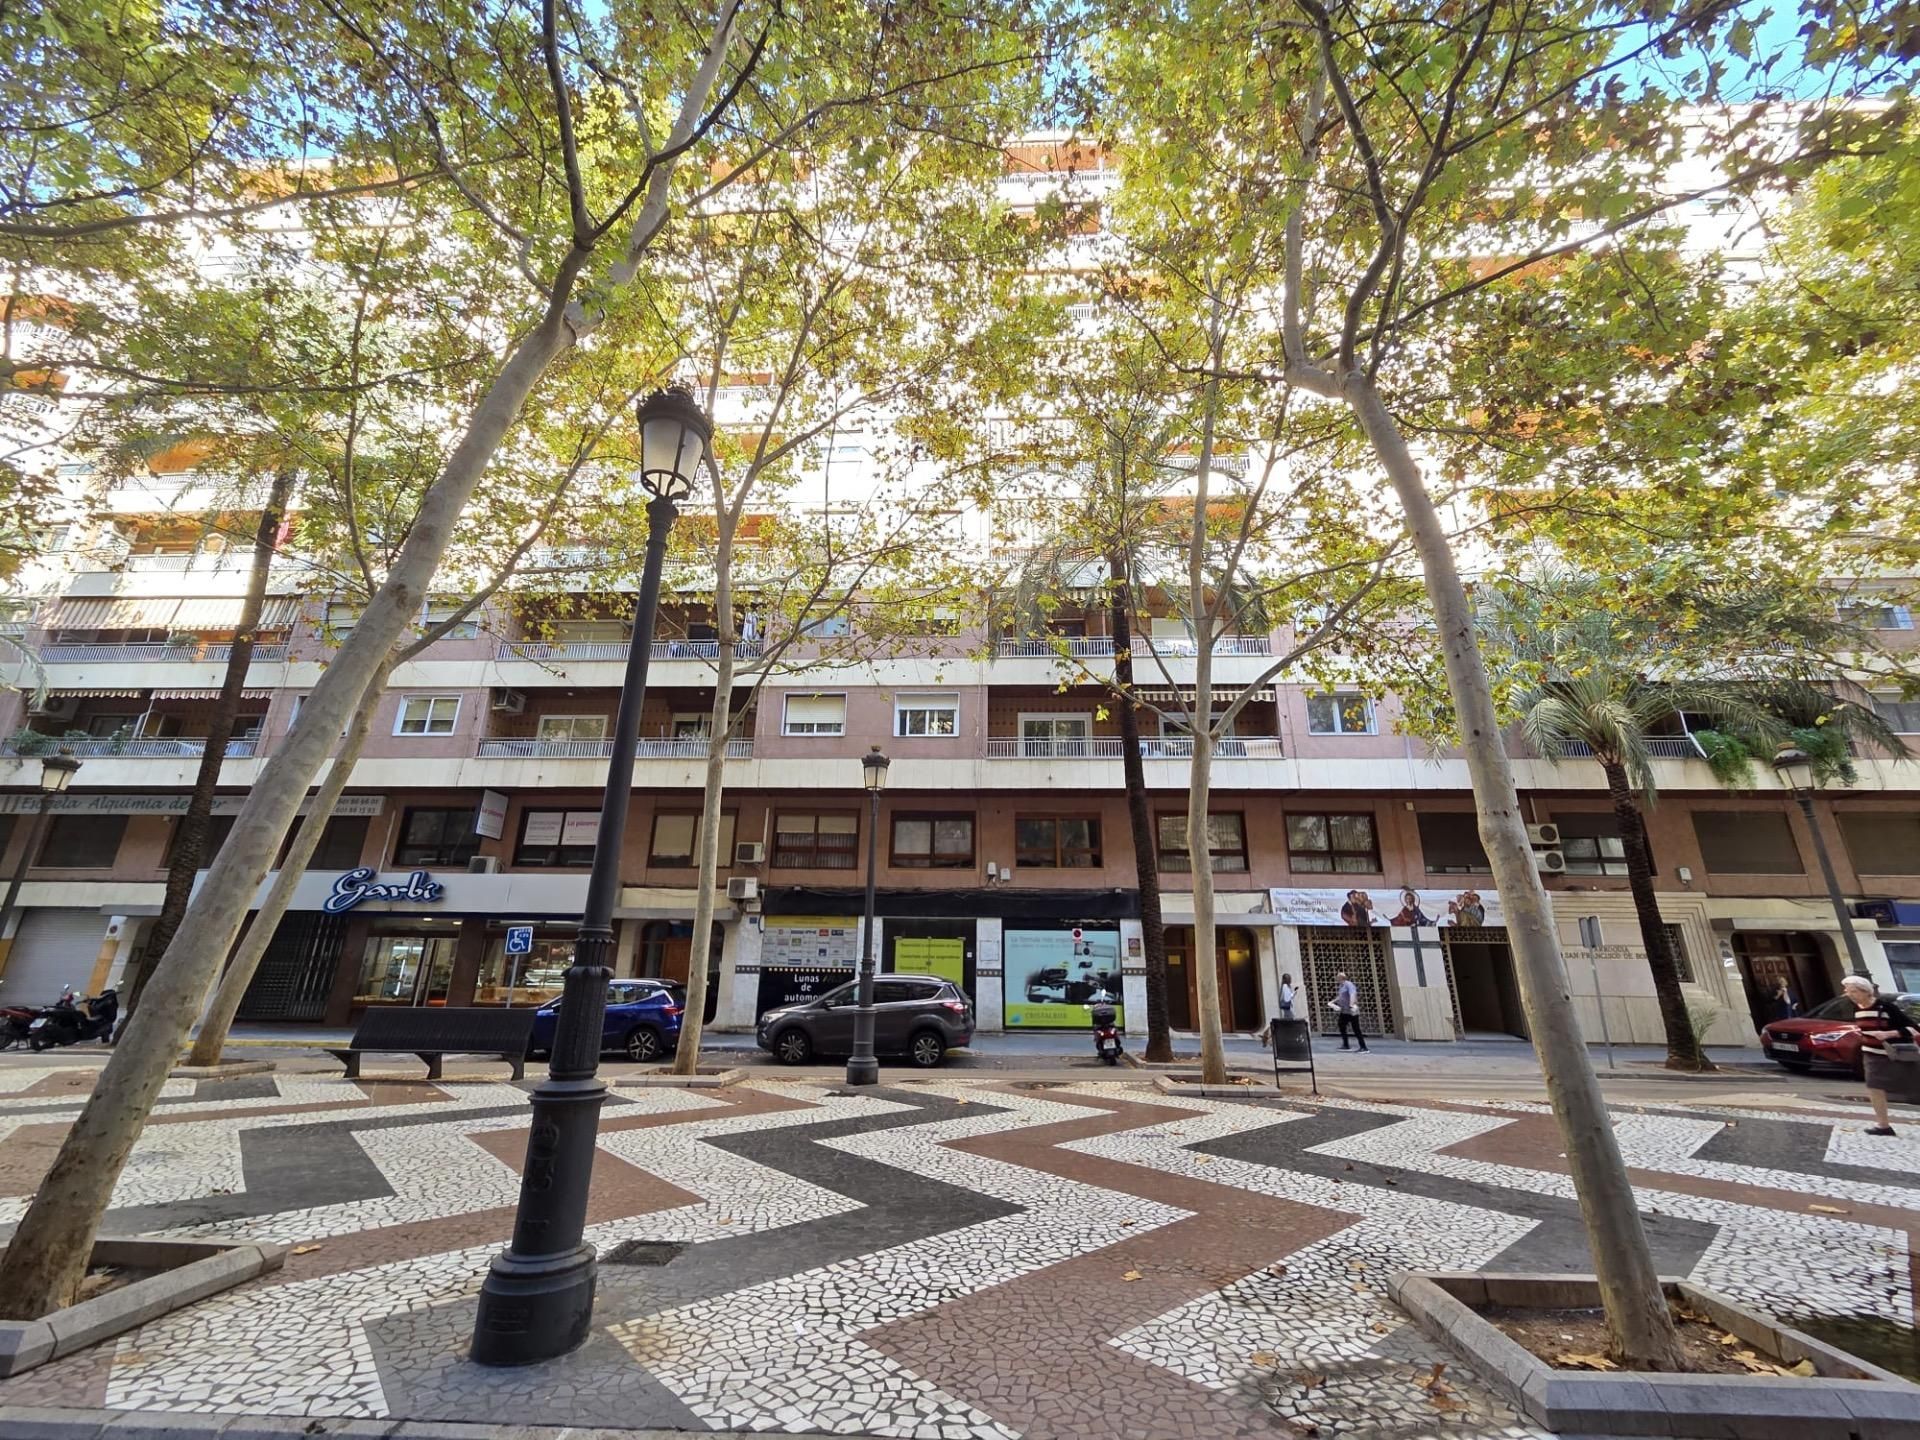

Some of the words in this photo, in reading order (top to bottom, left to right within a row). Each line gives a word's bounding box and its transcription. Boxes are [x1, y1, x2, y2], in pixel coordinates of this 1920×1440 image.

[20, 796, 80, 810] Escela
[87, 796, 167, 813] Alquimia
[325, 868, 441, 912] Garbi
[1594, 945, 1630, 953] ARROQUIA
[794, 973, 820, 983] Lunas
[801, 982, 812, 992] de
[784, 993, 823, 1002] automo
